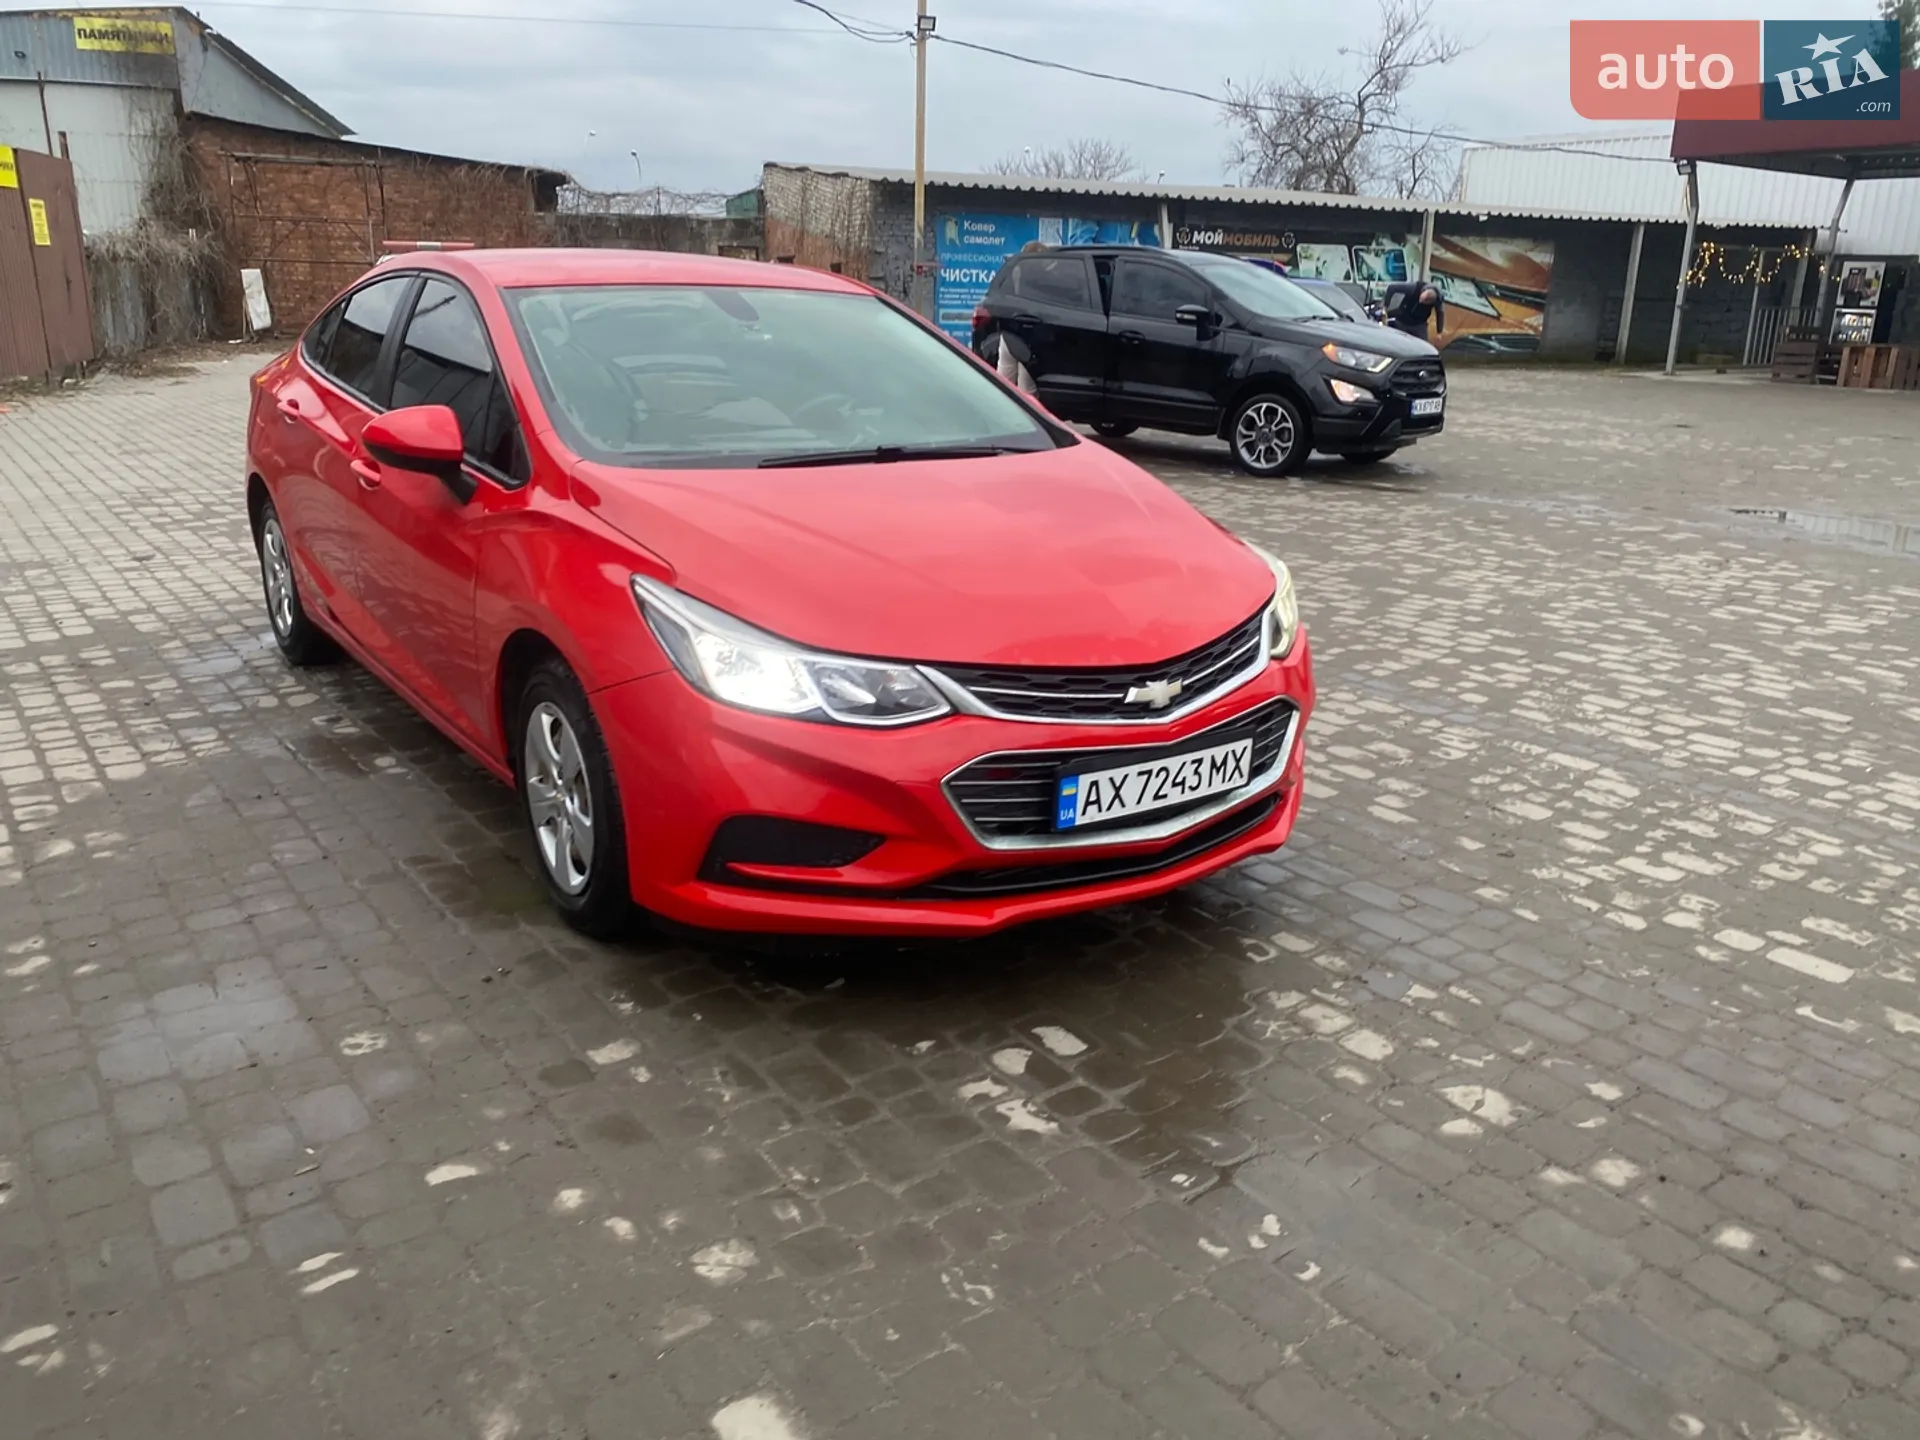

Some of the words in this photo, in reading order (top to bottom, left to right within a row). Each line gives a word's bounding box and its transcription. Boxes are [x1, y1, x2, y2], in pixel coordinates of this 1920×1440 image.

[963, 220, 996, 234] Ковер
[963, 235, 1005, 245] самолет
[1081, 773, 1129, 817] AX
[1135, 757, 1204, 806] 7243
[1208, 745, 1249, 788] MX
[1060, 809, 1075, 821] UA
